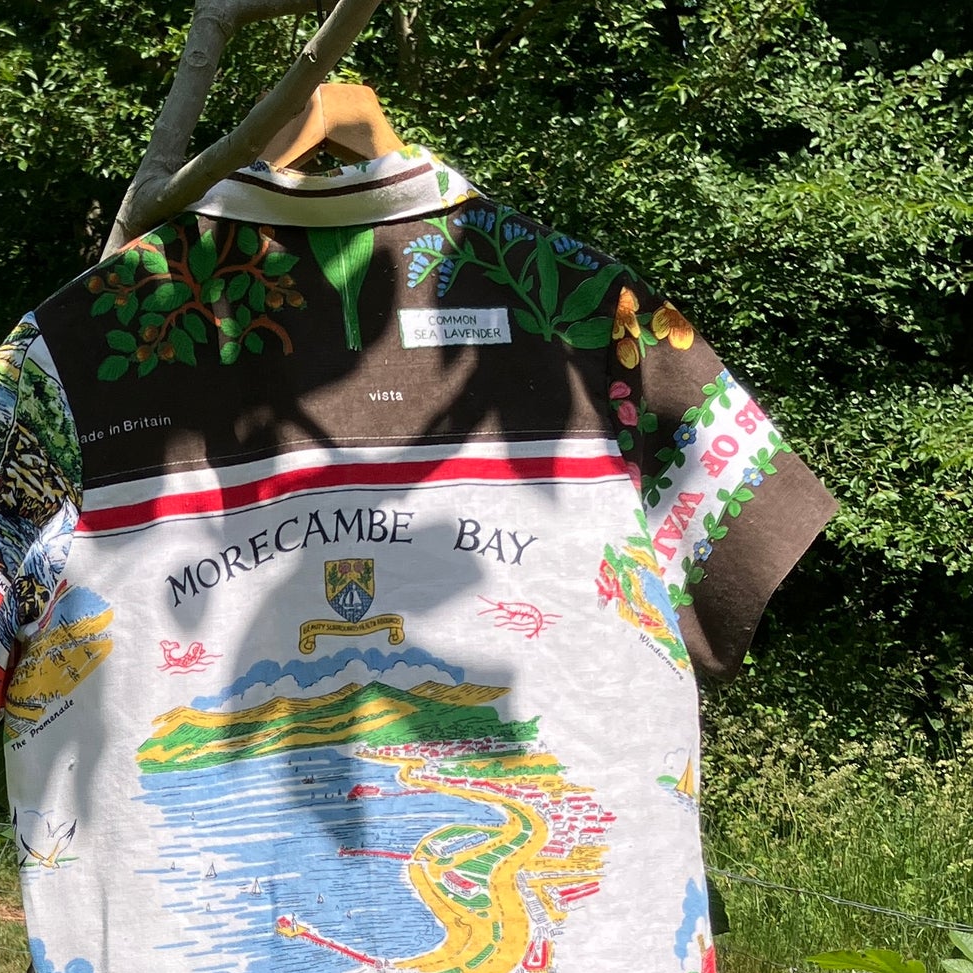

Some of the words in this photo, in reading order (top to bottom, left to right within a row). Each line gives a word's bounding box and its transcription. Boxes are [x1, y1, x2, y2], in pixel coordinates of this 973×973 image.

[428, 315, 477, 326] COMMON
[414, 328, 438, 340] SEA
[443, 327, 502, 339] LAVENDER
[368, 389, 404, 401] vista
[109, 424, 121, 436] in
[123, 414, 172, 432] Britain
[699, 434, 739, 479] OF
[164, 508, 415, 608] MORECAMBE
[453, 517, 539, 566] BAY
[11, 738, 27, 752] The
[30, 700, 74, 738] Promenade
